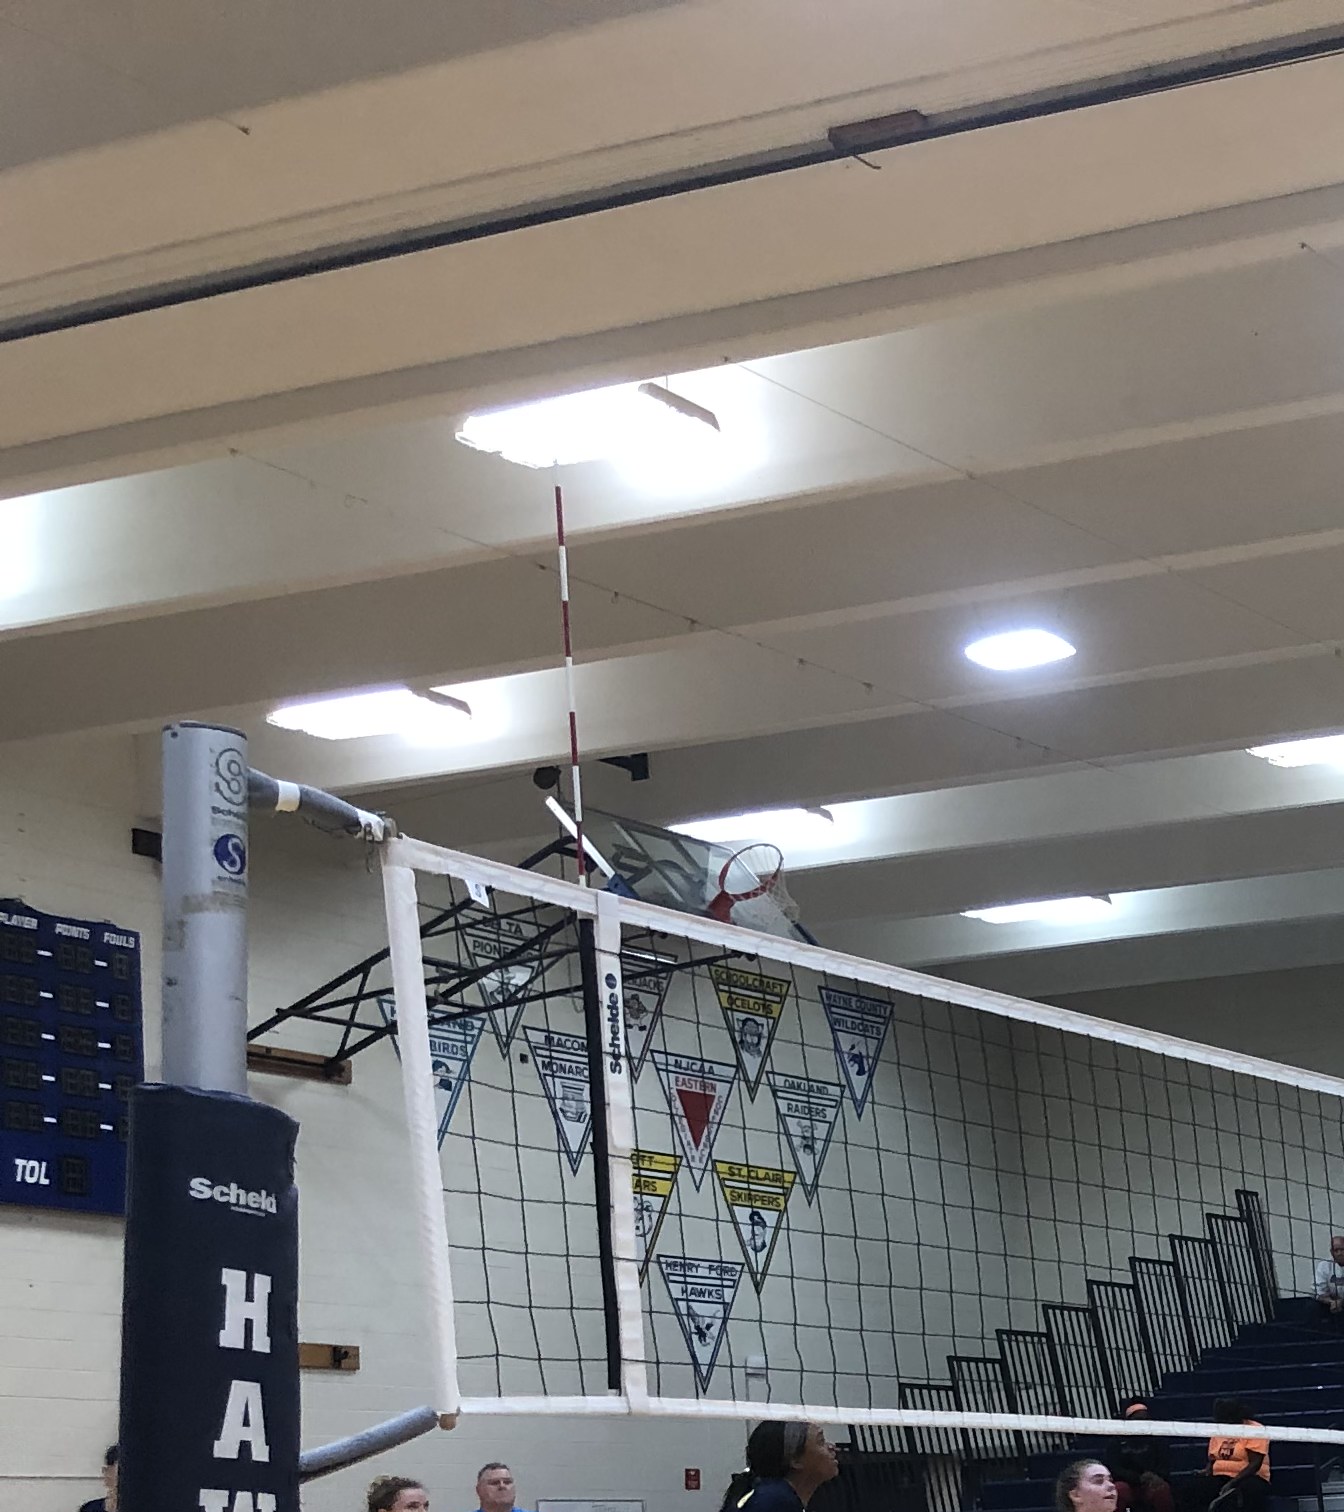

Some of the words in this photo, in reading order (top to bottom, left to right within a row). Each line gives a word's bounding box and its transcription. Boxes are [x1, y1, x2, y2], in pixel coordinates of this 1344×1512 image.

[55, 923, 90, 940] POINTS
[104, 931, 135, 949] FOULS
[713, 968, 785, 994] SCHOOLCRAFT
[726, 995, 774, 1014] OCELOTS
[824, 993, 854, 1009] WAYNE
[855, 998, 888, 1016] COUNTY
[609, 992, 622, 1075] Schelde
[833, 1016, 882, 1037] WILDCATS
[544, 1035, 588, 1053] MACOM
[541, 1060, 590, 1078] MONARC
[673, 1059, 715, 1075] NJCAA
[675, 1076, 717, 1093] EASTERN
[783, 1078, 829, 1096] OAKLAND
[786, 1102, 827, 1119] RAIDERS
[14, 1158, 51, 1185] TOL
[747, 1170, 783, 1184] CLAIR
[634, 1179, 657, 1193] ARS
[189, 1177, 278, 1214] Scheld
[729, 1191, 781, 1208] SKIPPERS
[665, 1259, 700, 1274] HENRY
[707, 1263, 738, 1277] FORD
[681, 1285, 722, 1300] HAWKS
